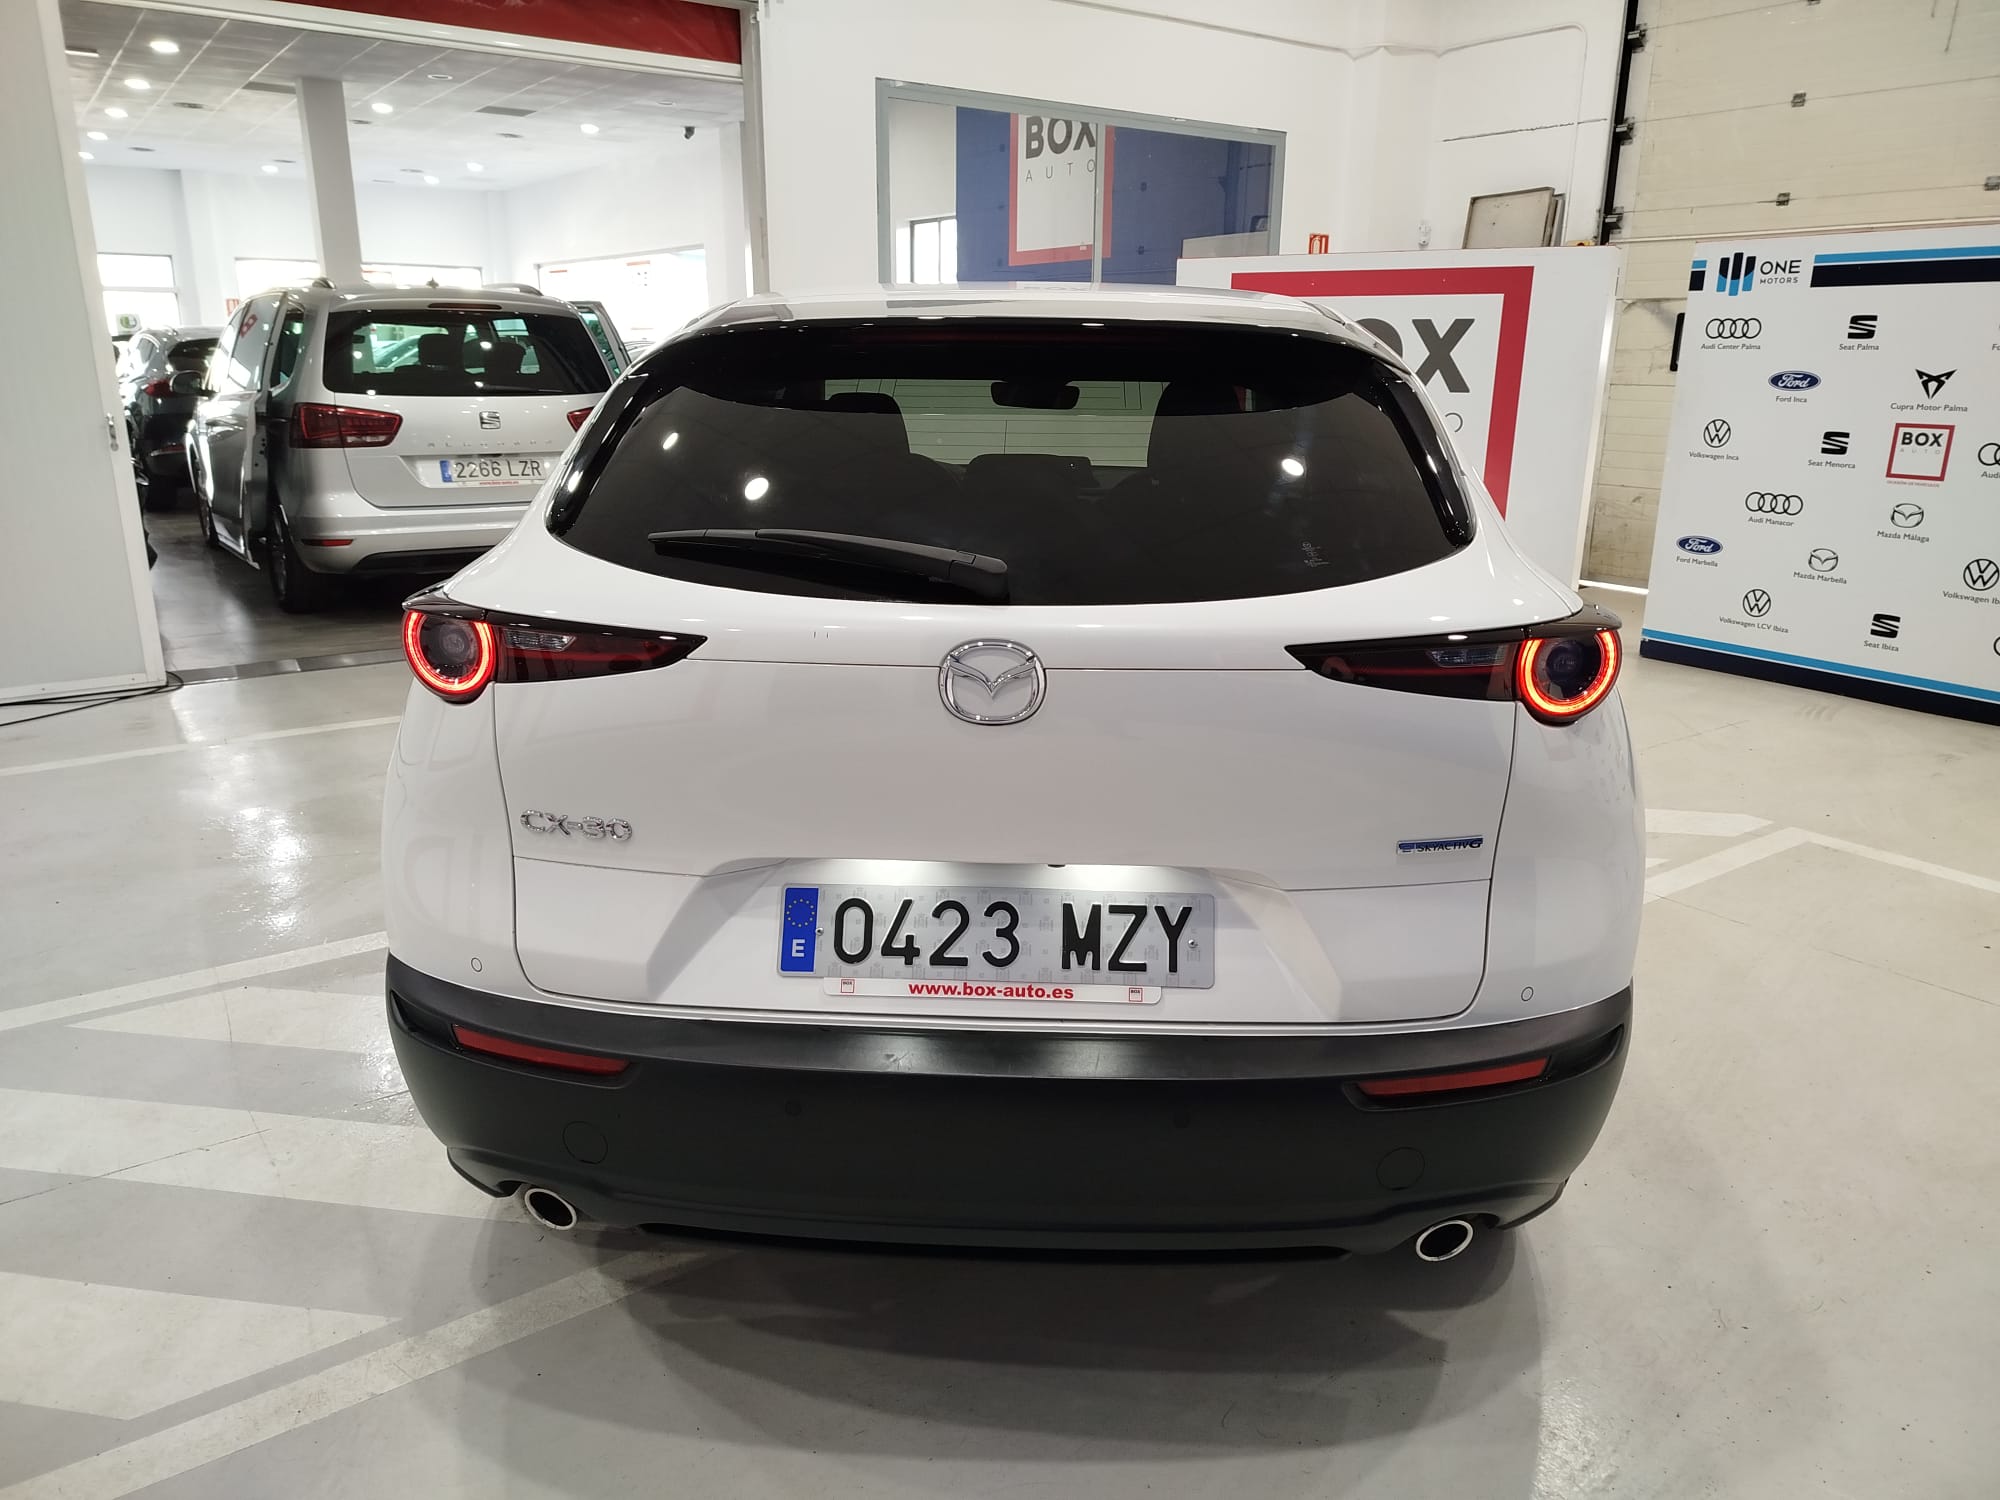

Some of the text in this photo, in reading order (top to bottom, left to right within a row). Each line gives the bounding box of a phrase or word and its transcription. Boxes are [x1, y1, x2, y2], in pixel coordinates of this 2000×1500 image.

[1026, 159, 1095, 182] AUTO
[1760, 259, 1802, 275] ONE
[1839, 343, 1880, 351] Seat Palma
[1777, 373, 1809, 388] Ford
[1775, 395, 1807, 403] Ford Inca
[1890, 402, 1968, 413] Cupra Motor Palma
[1901, 432, 1944, 447] BOX
[1689, 451, 1739, 461] Volkswagen Inca
[454, 460, 503, 479] 2266
[506, 459, 542, 477] LZR
[1808, 459, 1856, 469] Seat Menorca
[1748, 515, 1794, 527] Audi Manacor
[1877, 530, 1901, 540] Mazda
[1684, 537, 1713, 553] Ford
[1676, 555, 1718, 567] Ford Marbella
[1793, 571, 1847, 585] Mazda Marbella
[1942, 590, 1990, 604] Volkswagen
[1719, 615, 1790, 634] Volkswagen LCV Ibiza
[1863, 640, 1899, 653] Seat Ibiza
[520, 809, 633, 842] CX-30
[833, 897, 1193, 974] 0423 MZY
[791, 938, 806, 958] E
[908, 982, 1074, 1000] www.box-auto.es
